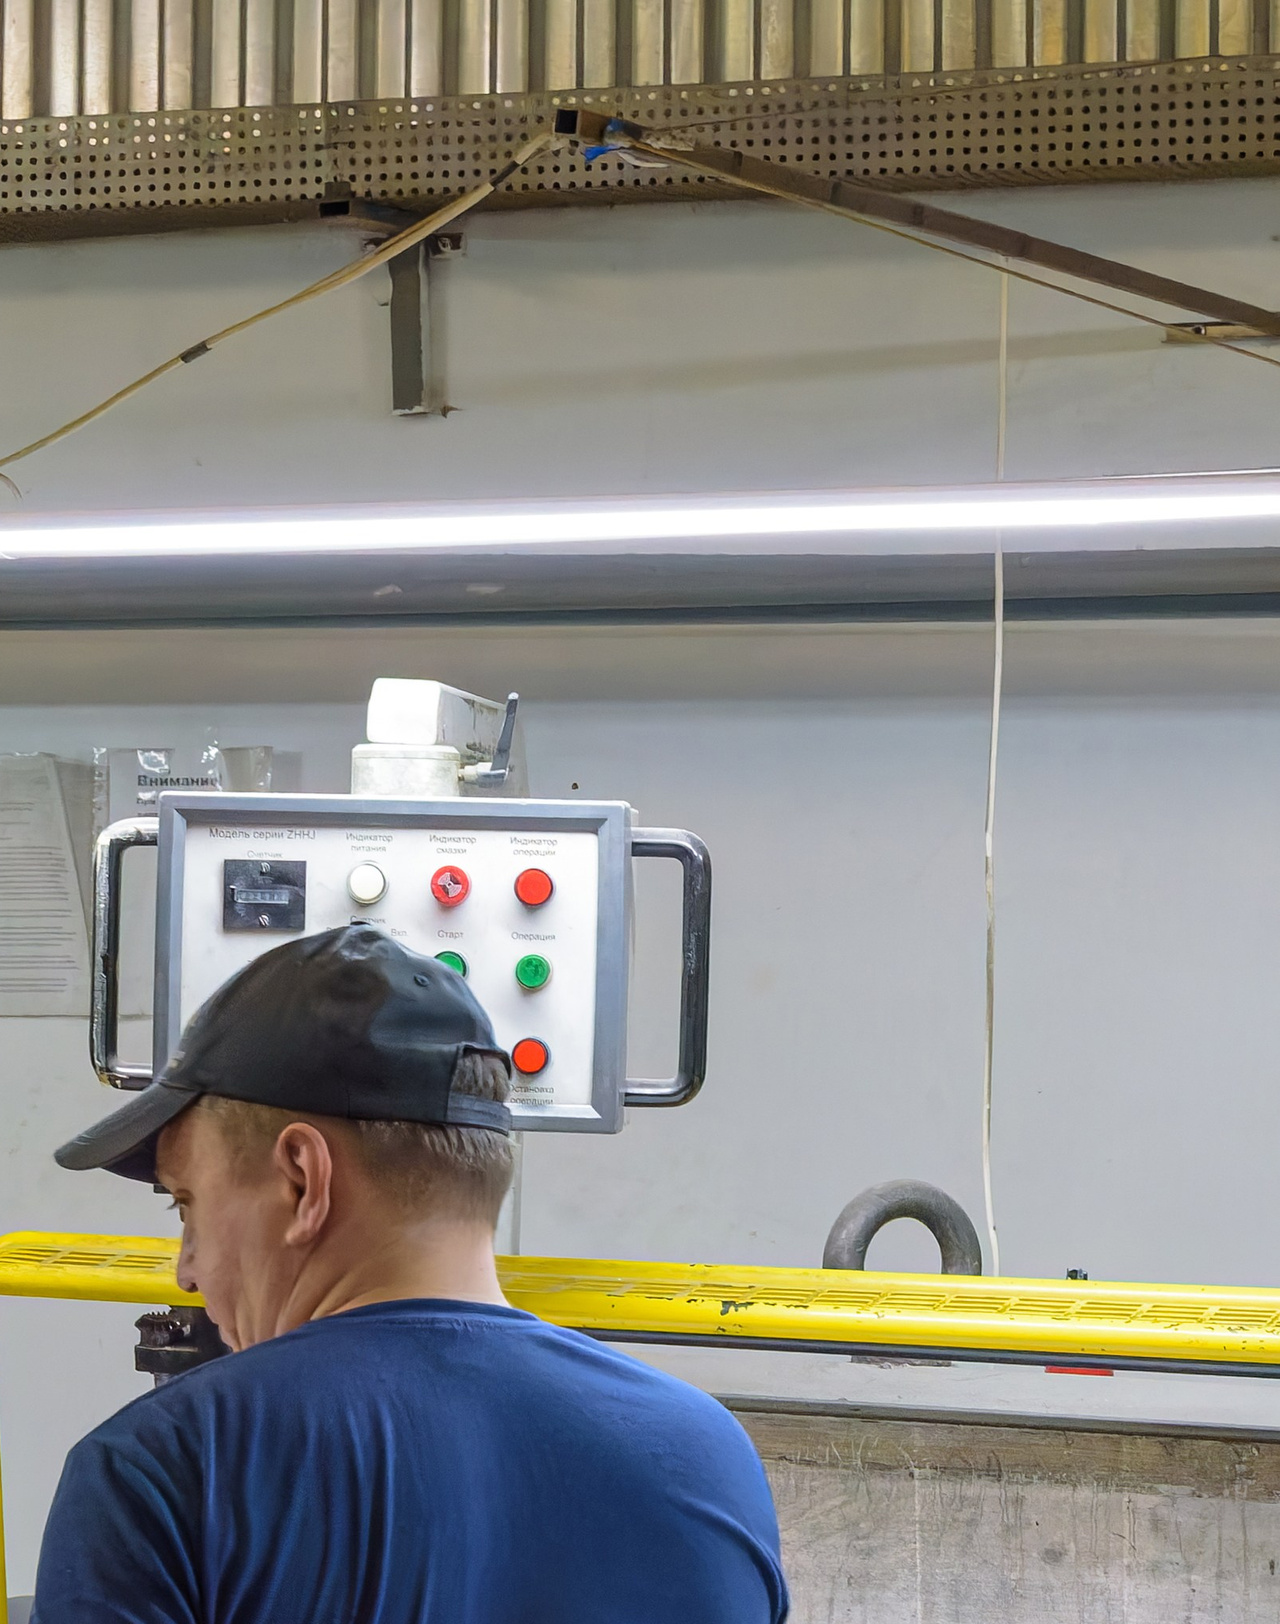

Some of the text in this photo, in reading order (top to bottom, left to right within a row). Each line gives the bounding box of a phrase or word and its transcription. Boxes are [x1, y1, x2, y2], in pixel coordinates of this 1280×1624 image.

[209, 828, 250, 839] Модель
[253, 830, 283, 840] серии
[346, 832, 394, 842] Индикатор
[429, 834, 477, 844] Индикатор
[510, 836, 558, 846] Индикатор
[350, 845, 387, 853] питания
[437, 930, 464, 940] Старт
[511, 931, 556, 941] Операция
